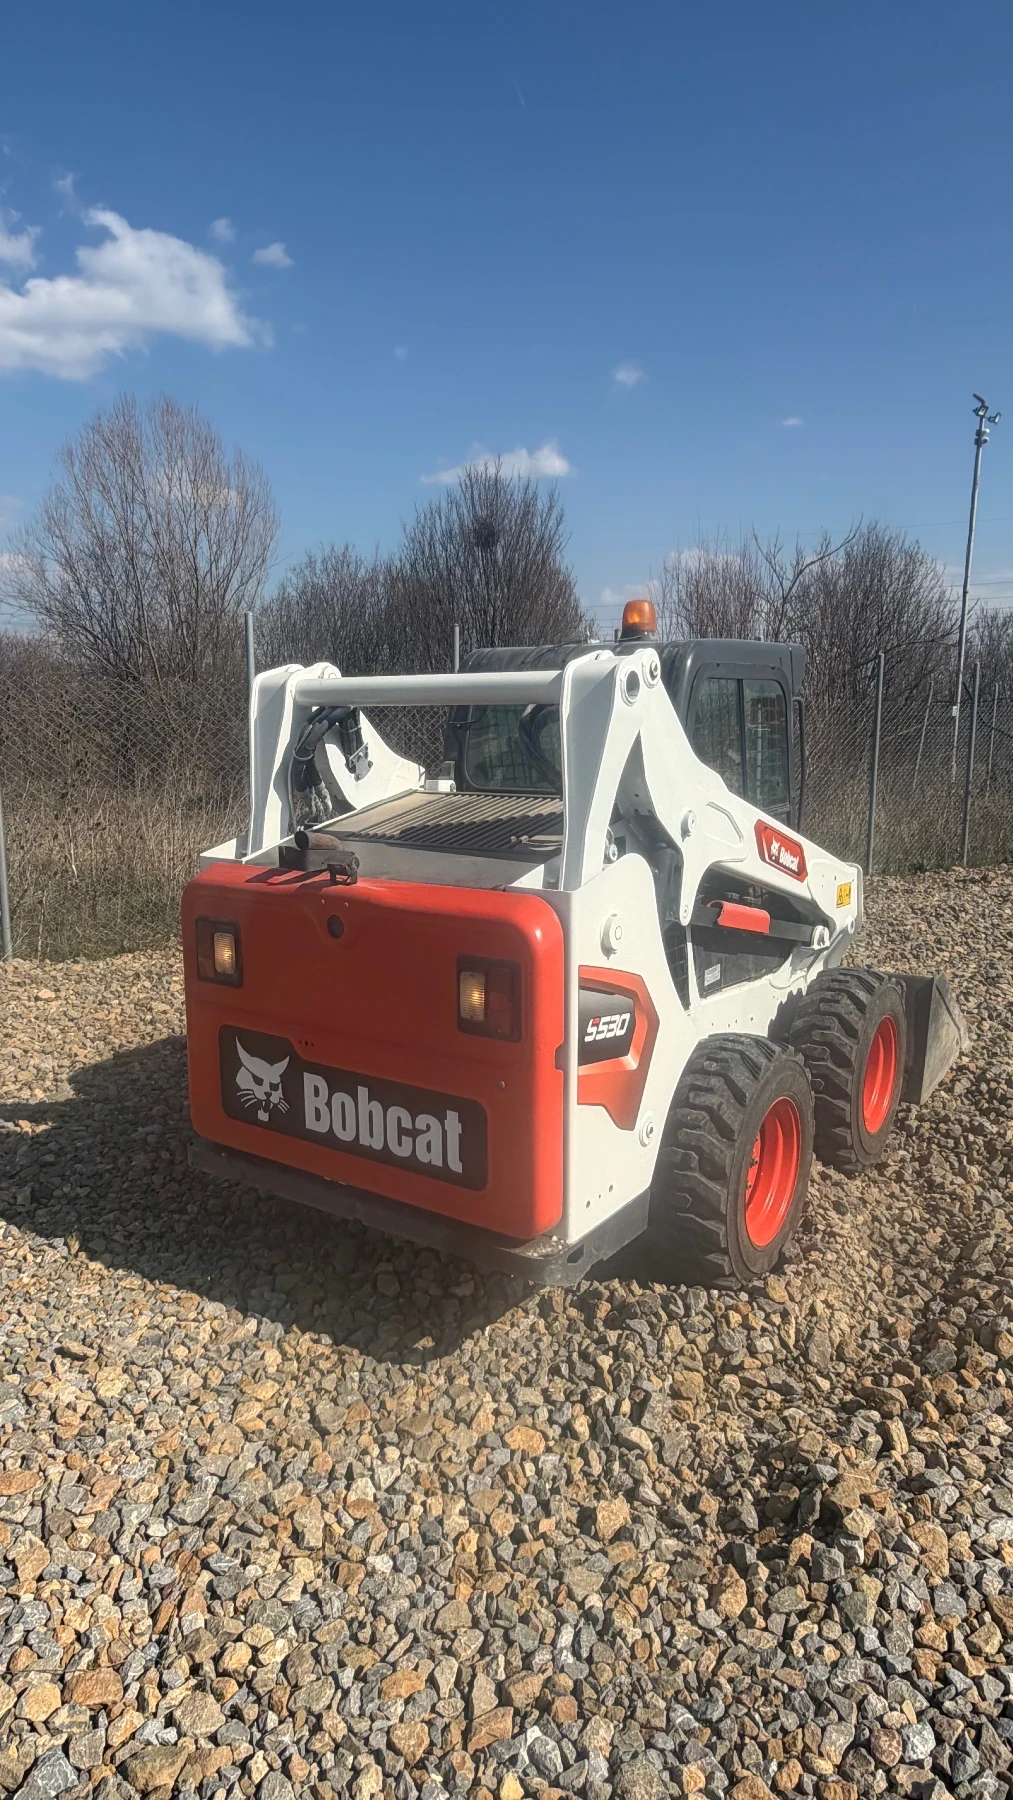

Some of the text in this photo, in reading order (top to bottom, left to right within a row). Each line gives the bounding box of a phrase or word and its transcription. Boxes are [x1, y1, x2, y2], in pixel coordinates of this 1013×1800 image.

[779, 847, 799, 872] Bobcat
[584, 1012, 631, 1042] S530
[303, 1071, 463, 1173] Bobcat
